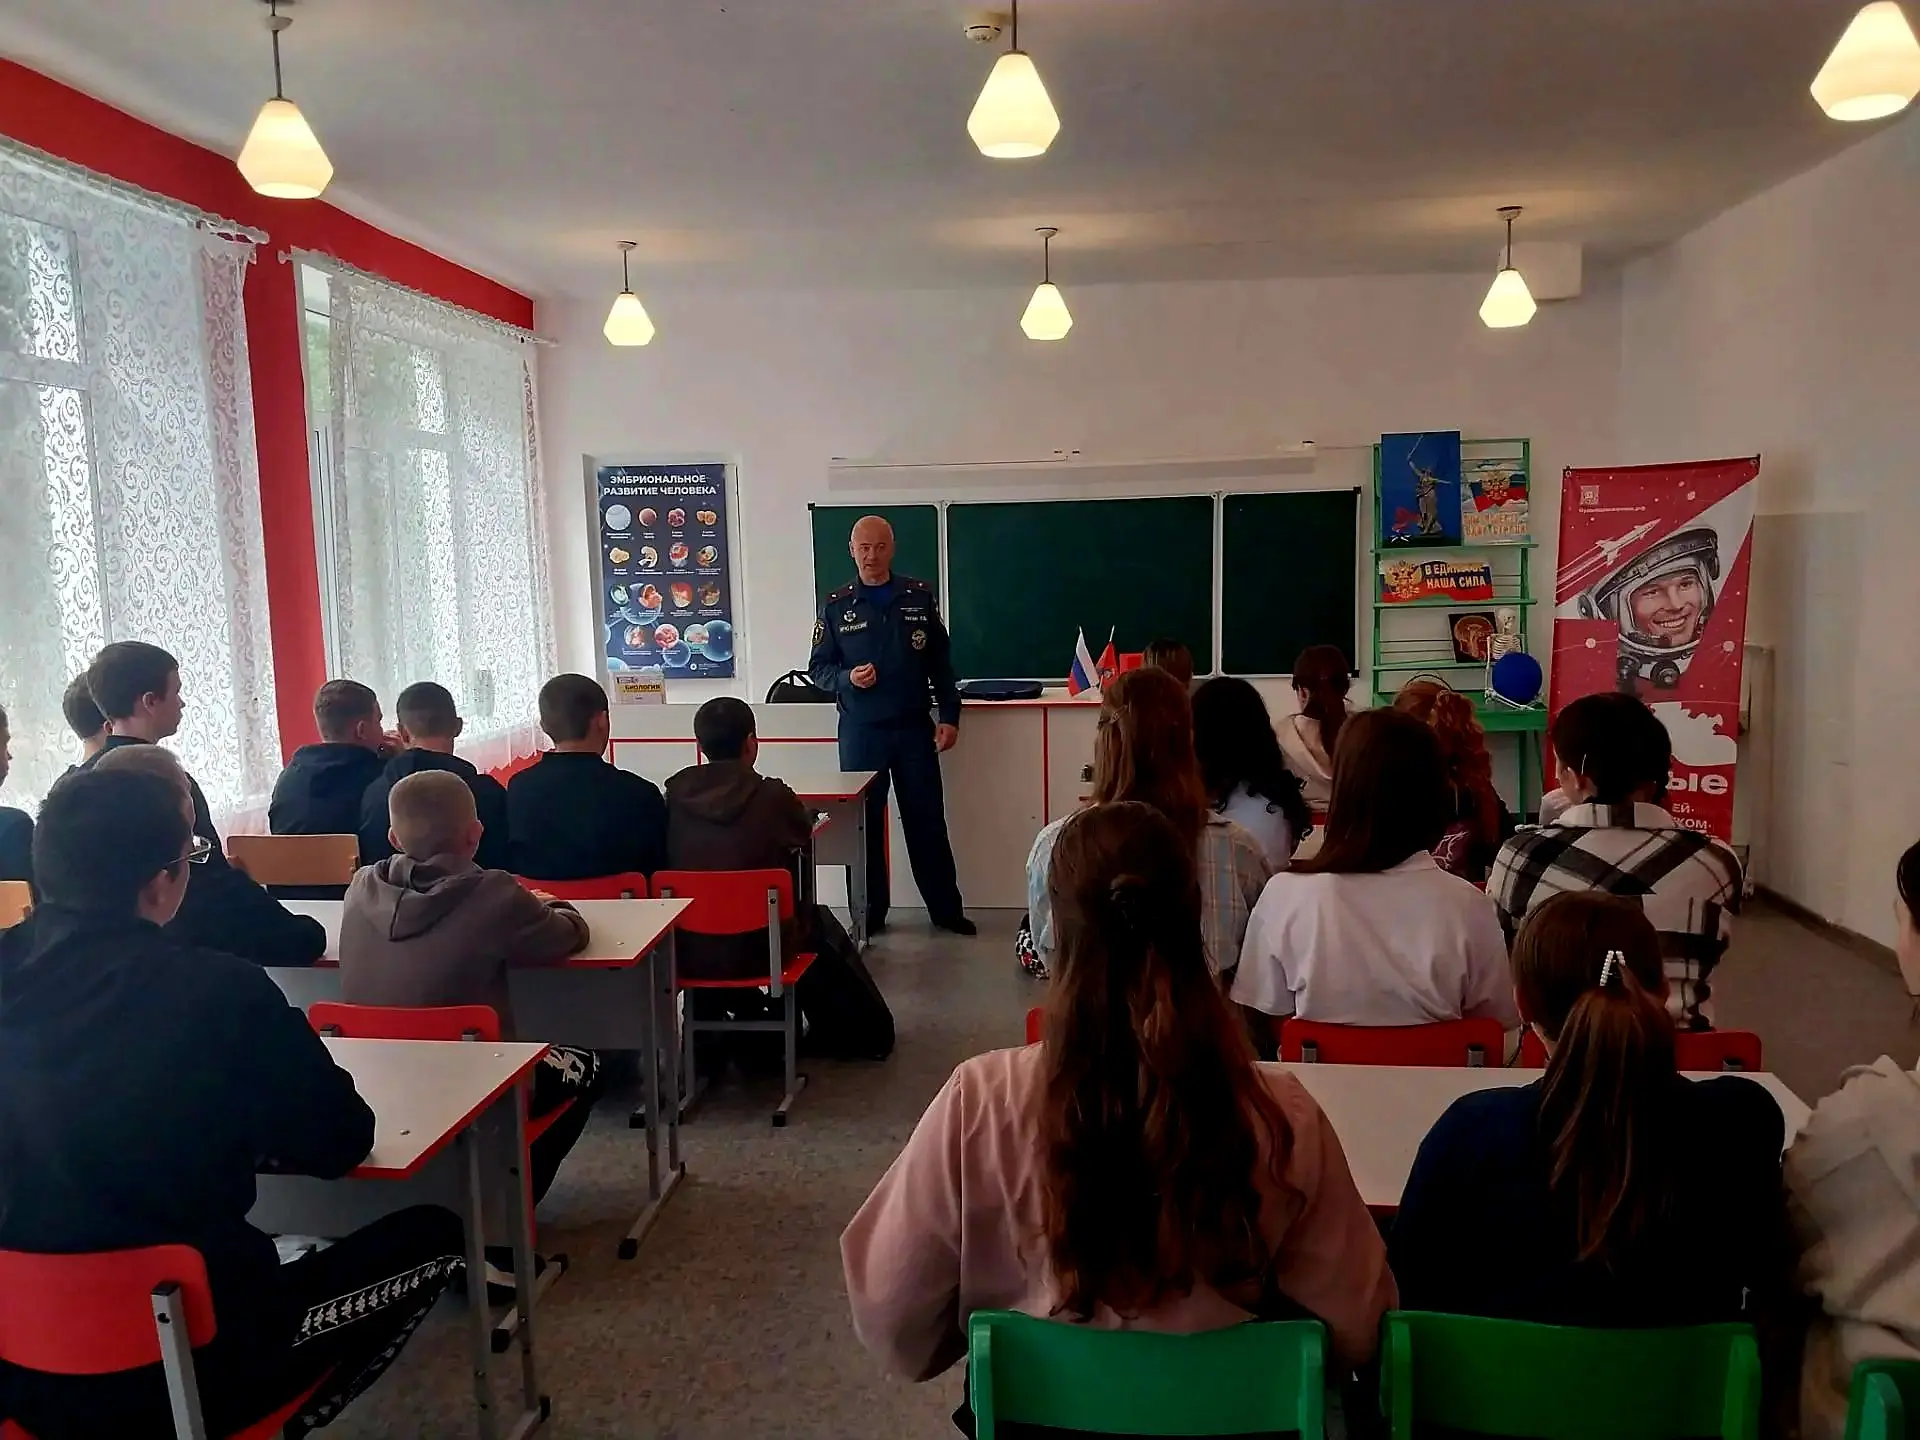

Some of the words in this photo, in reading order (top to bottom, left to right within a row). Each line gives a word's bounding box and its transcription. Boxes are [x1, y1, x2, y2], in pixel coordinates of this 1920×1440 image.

[610, 475, 706, 484] ЭМБРИОНАЛЬНОЕ
[604, 487, 658, 496] РАЗВИТИЕ
[660, 486, 717, 495] ЧЕЛОВЕКА
[1424, 564, 1432, 576] В
[1426, 577, 1457, 589] НАША
[1459, 575, 1486, 588] СИЛА
